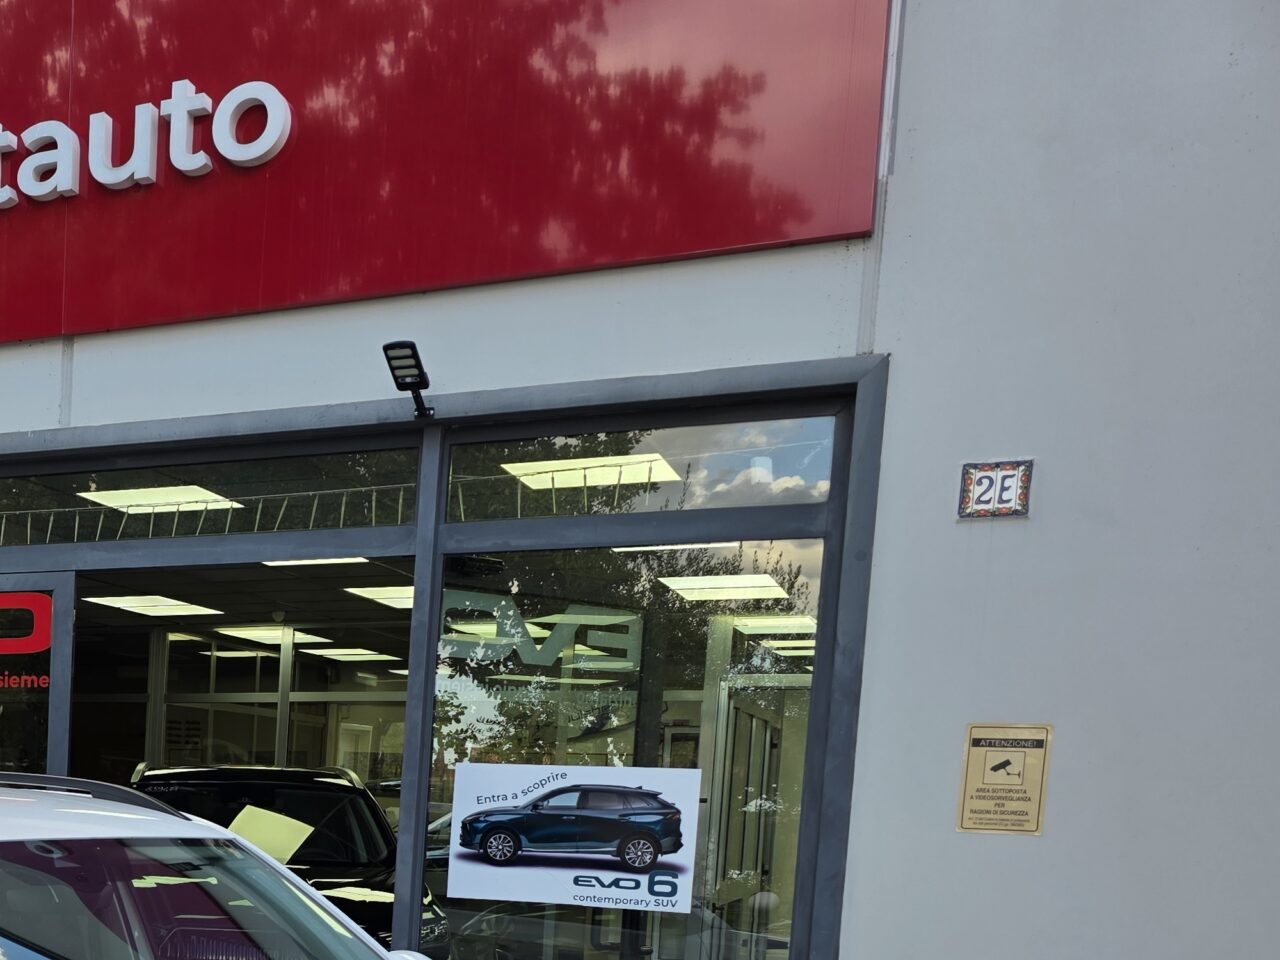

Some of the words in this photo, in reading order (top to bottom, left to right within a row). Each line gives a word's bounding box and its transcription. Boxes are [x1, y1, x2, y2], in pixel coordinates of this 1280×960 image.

[975, 474, 1017, 505] 2E
[979, 739, 1037, 747] ATTENZIONE!
[476, 792, 508, 805] Entra
[511, 793, 519, 801] a
[521, 772, 568, 797] scoprire
[573, 874, 641, 890] EVO
[647, 870, 679, 898] 6
[573, 893, 652, 908] contemporary
[653, 898, 679, 908] SUV
